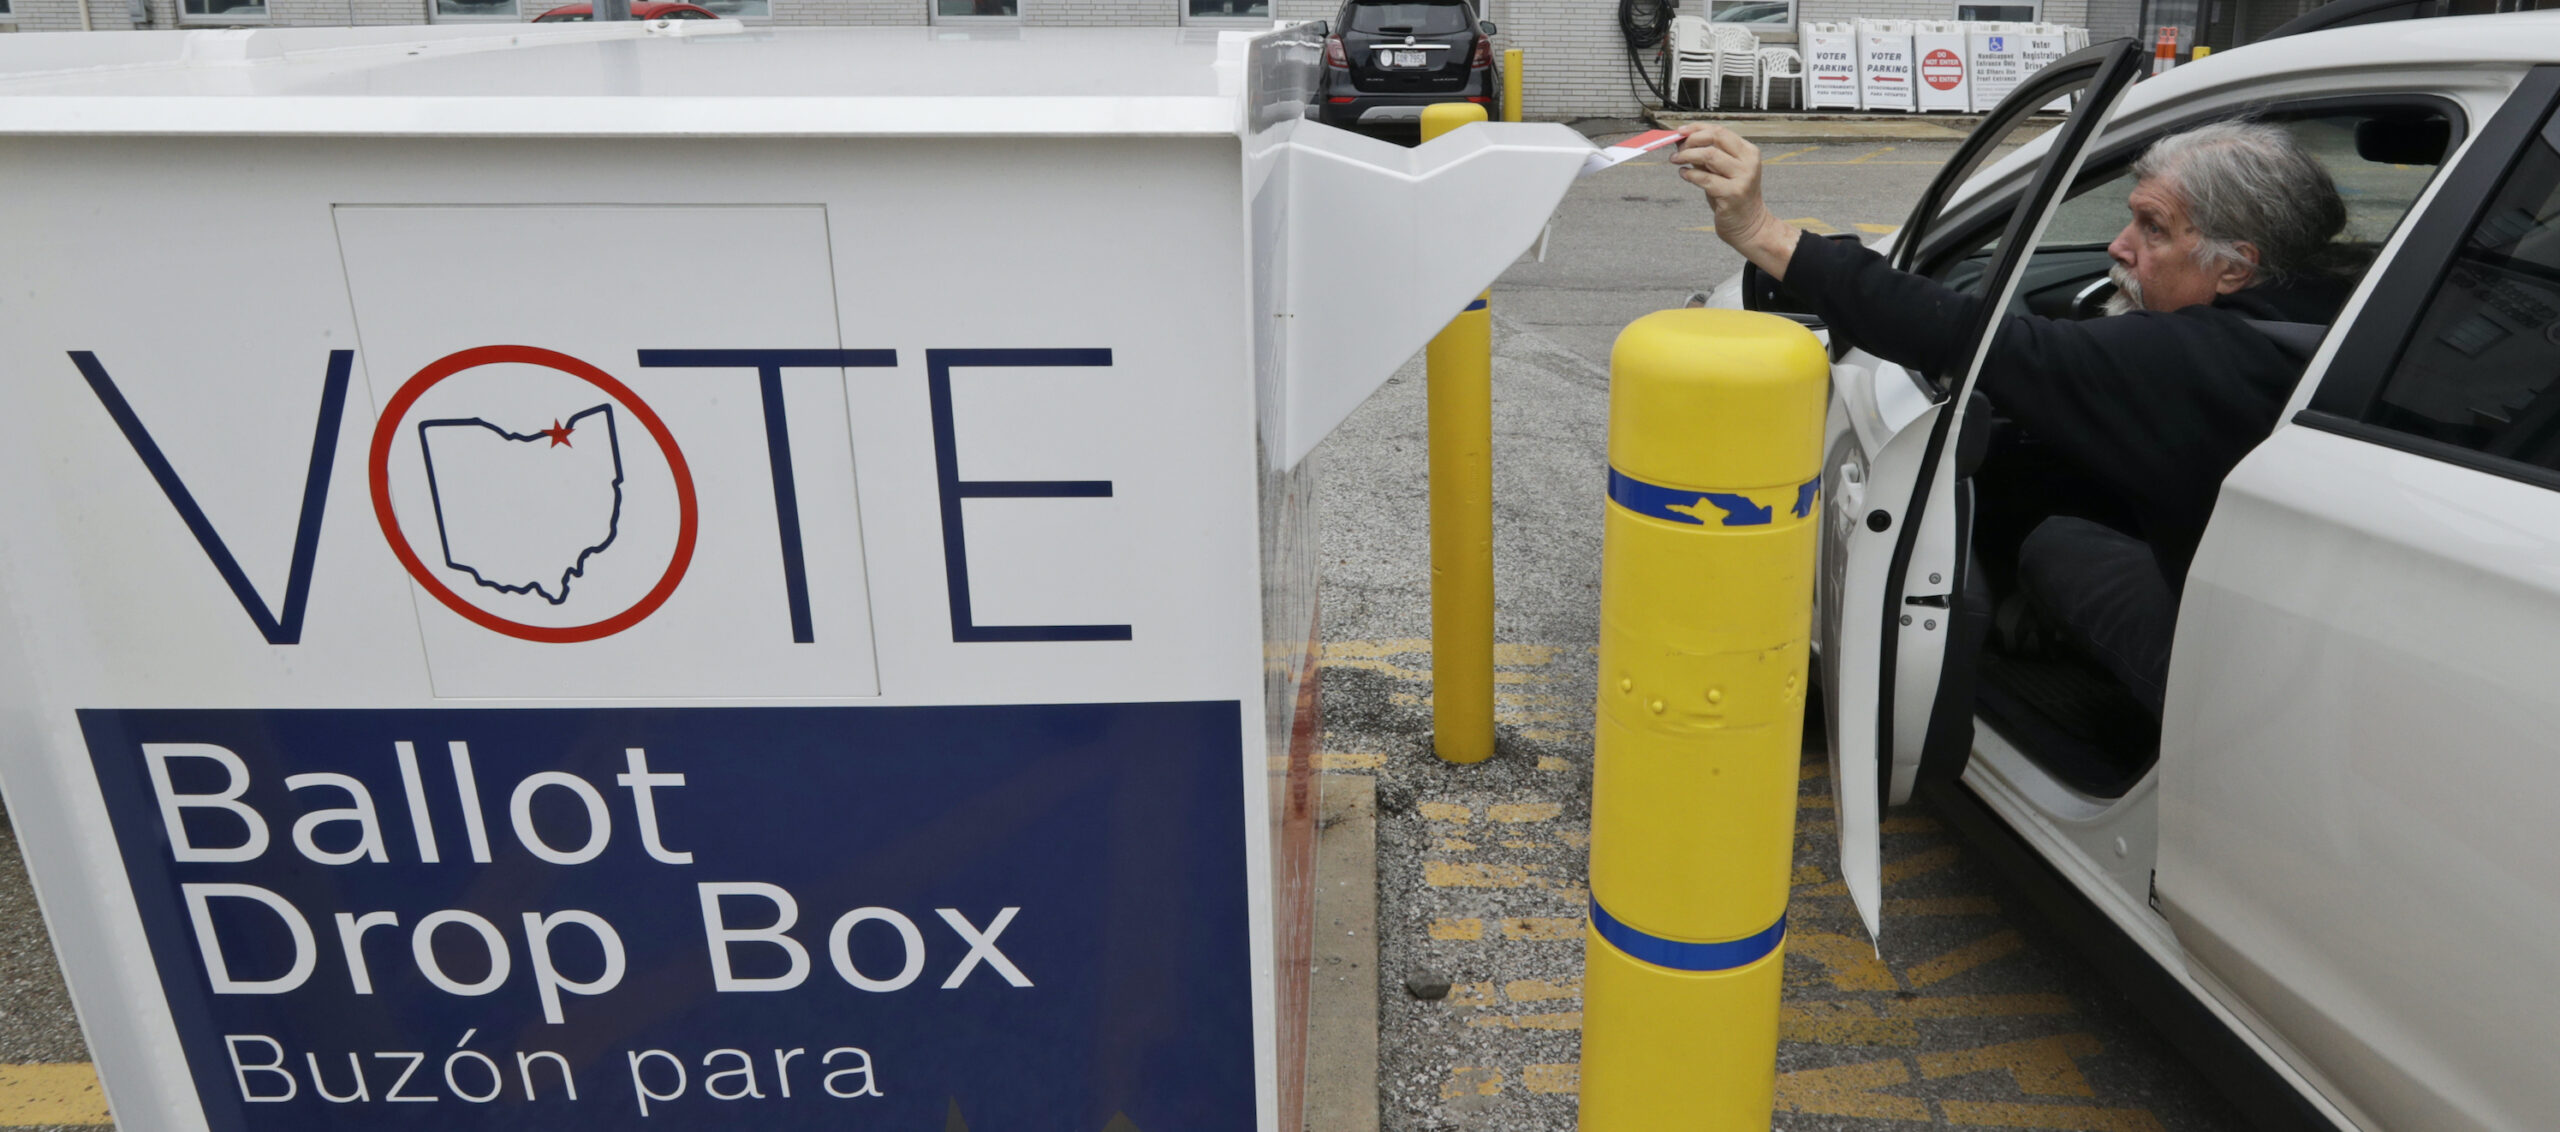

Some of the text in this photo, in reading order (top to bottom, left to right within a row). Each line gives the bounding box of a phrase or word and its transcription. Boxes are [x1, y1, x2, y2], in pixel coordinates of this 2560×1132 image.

[1816, 52, 1847, 60] VOTER
[1871, 52, 1902, 60] VOTER
[2022, 51, 2062, 60] Registration
[1812, 64, 1854, 72] PARKING
[1866, 64, 1908, 73] PARKING
[67, 344, 1133, 645] VOTE
[141, 740, 694, 866] Ballot
[180, 881, 1035, 1025] Drop Box
[224, 1029, 884, 1118] Buzón para
